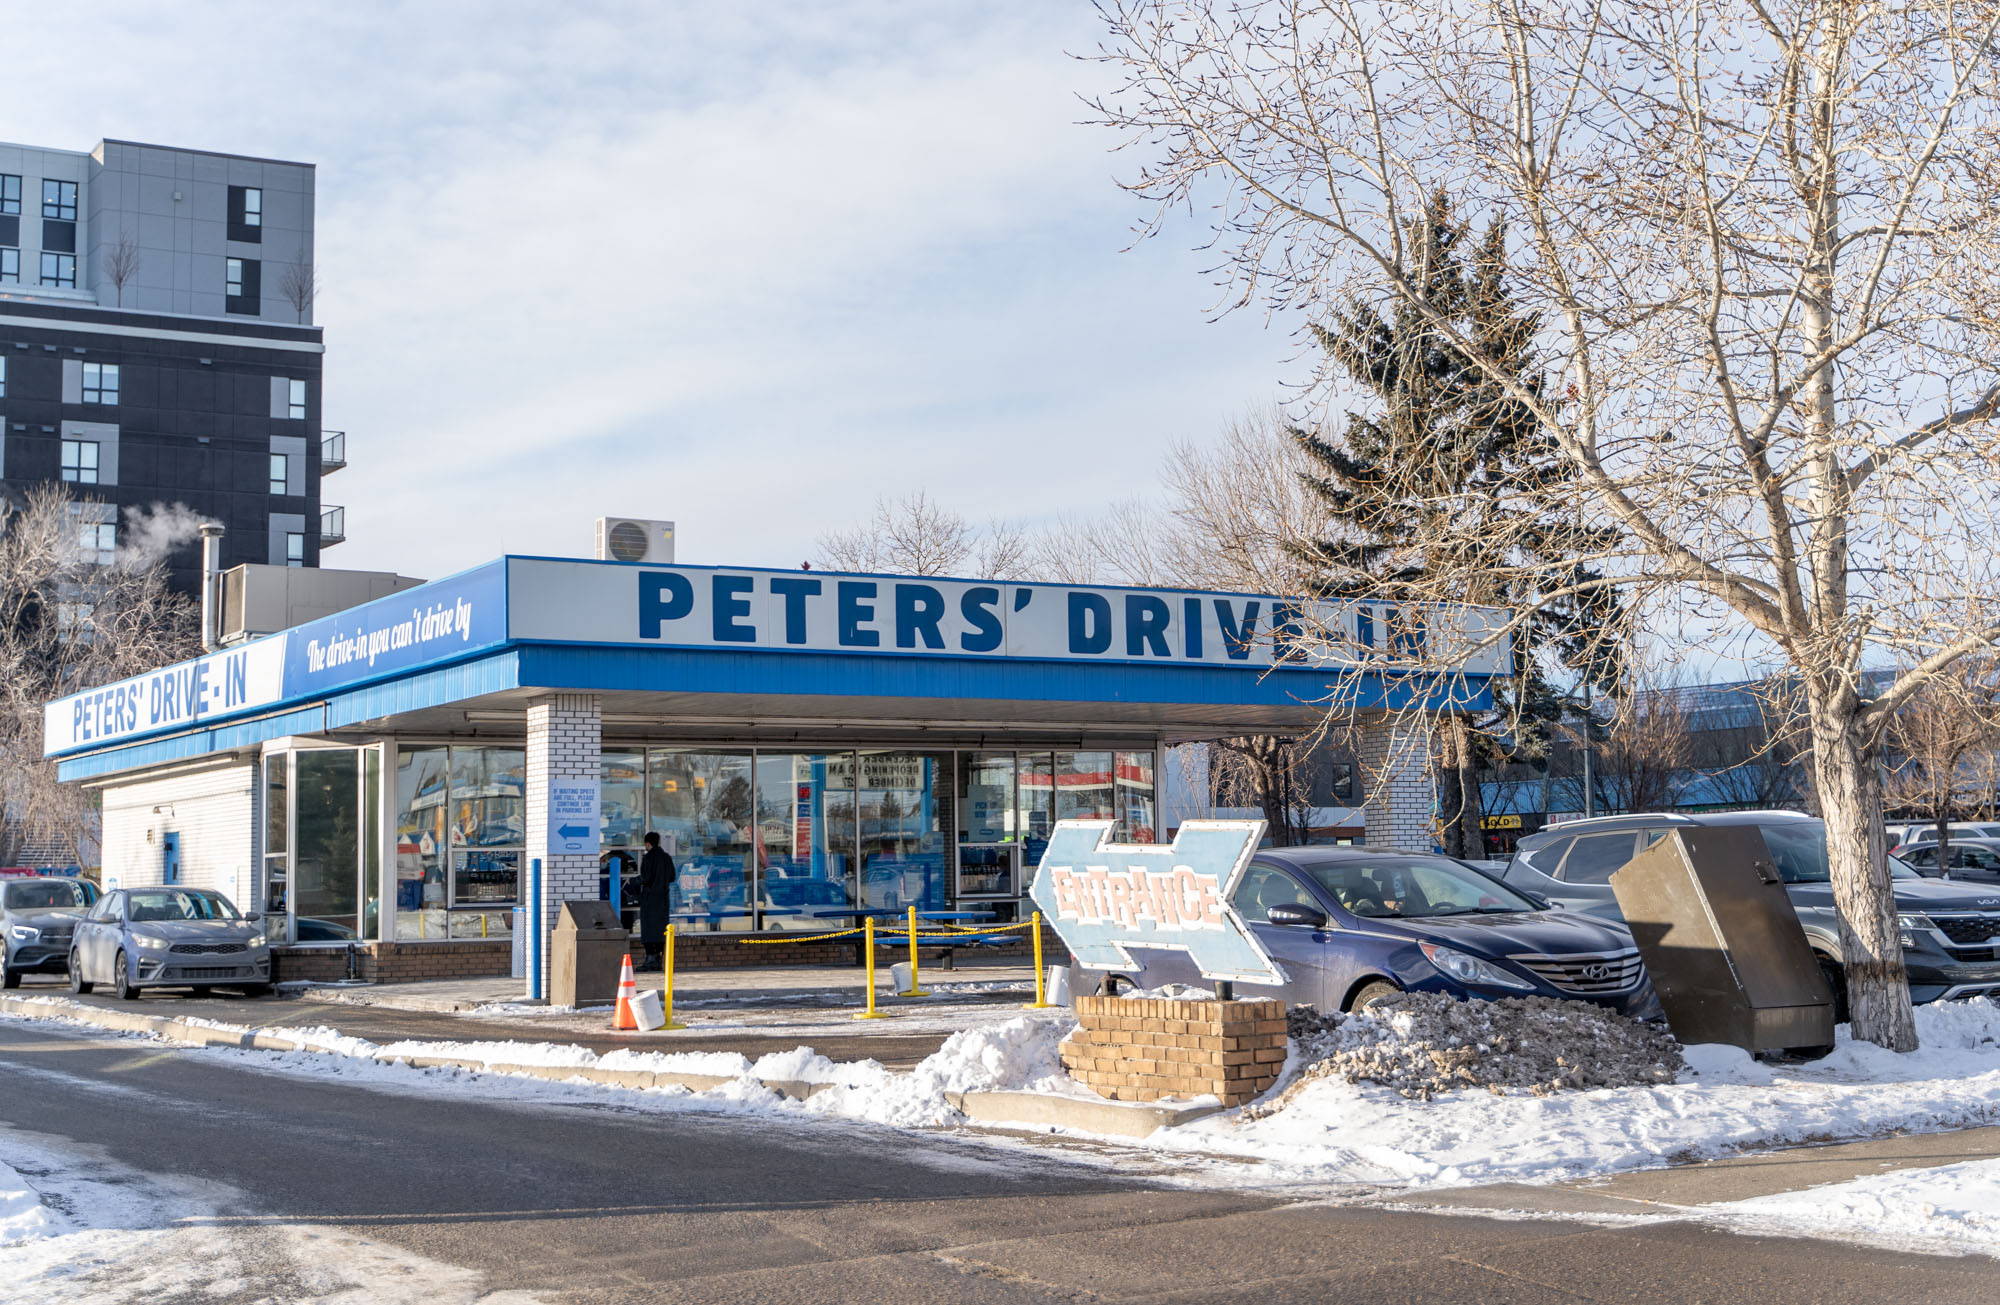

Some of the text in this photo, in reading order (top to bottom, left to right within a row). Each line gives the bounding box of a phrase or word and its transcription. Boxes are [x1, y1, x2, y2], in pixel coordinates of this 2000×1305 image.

[307, 596, 472, 673] The drive-in you can't drive by
[637, 570, 1033, 653] PETERS'
[73, 682, 143, 743] PETERS'
[1051, 866, 1225, 931] ENTRANCE
